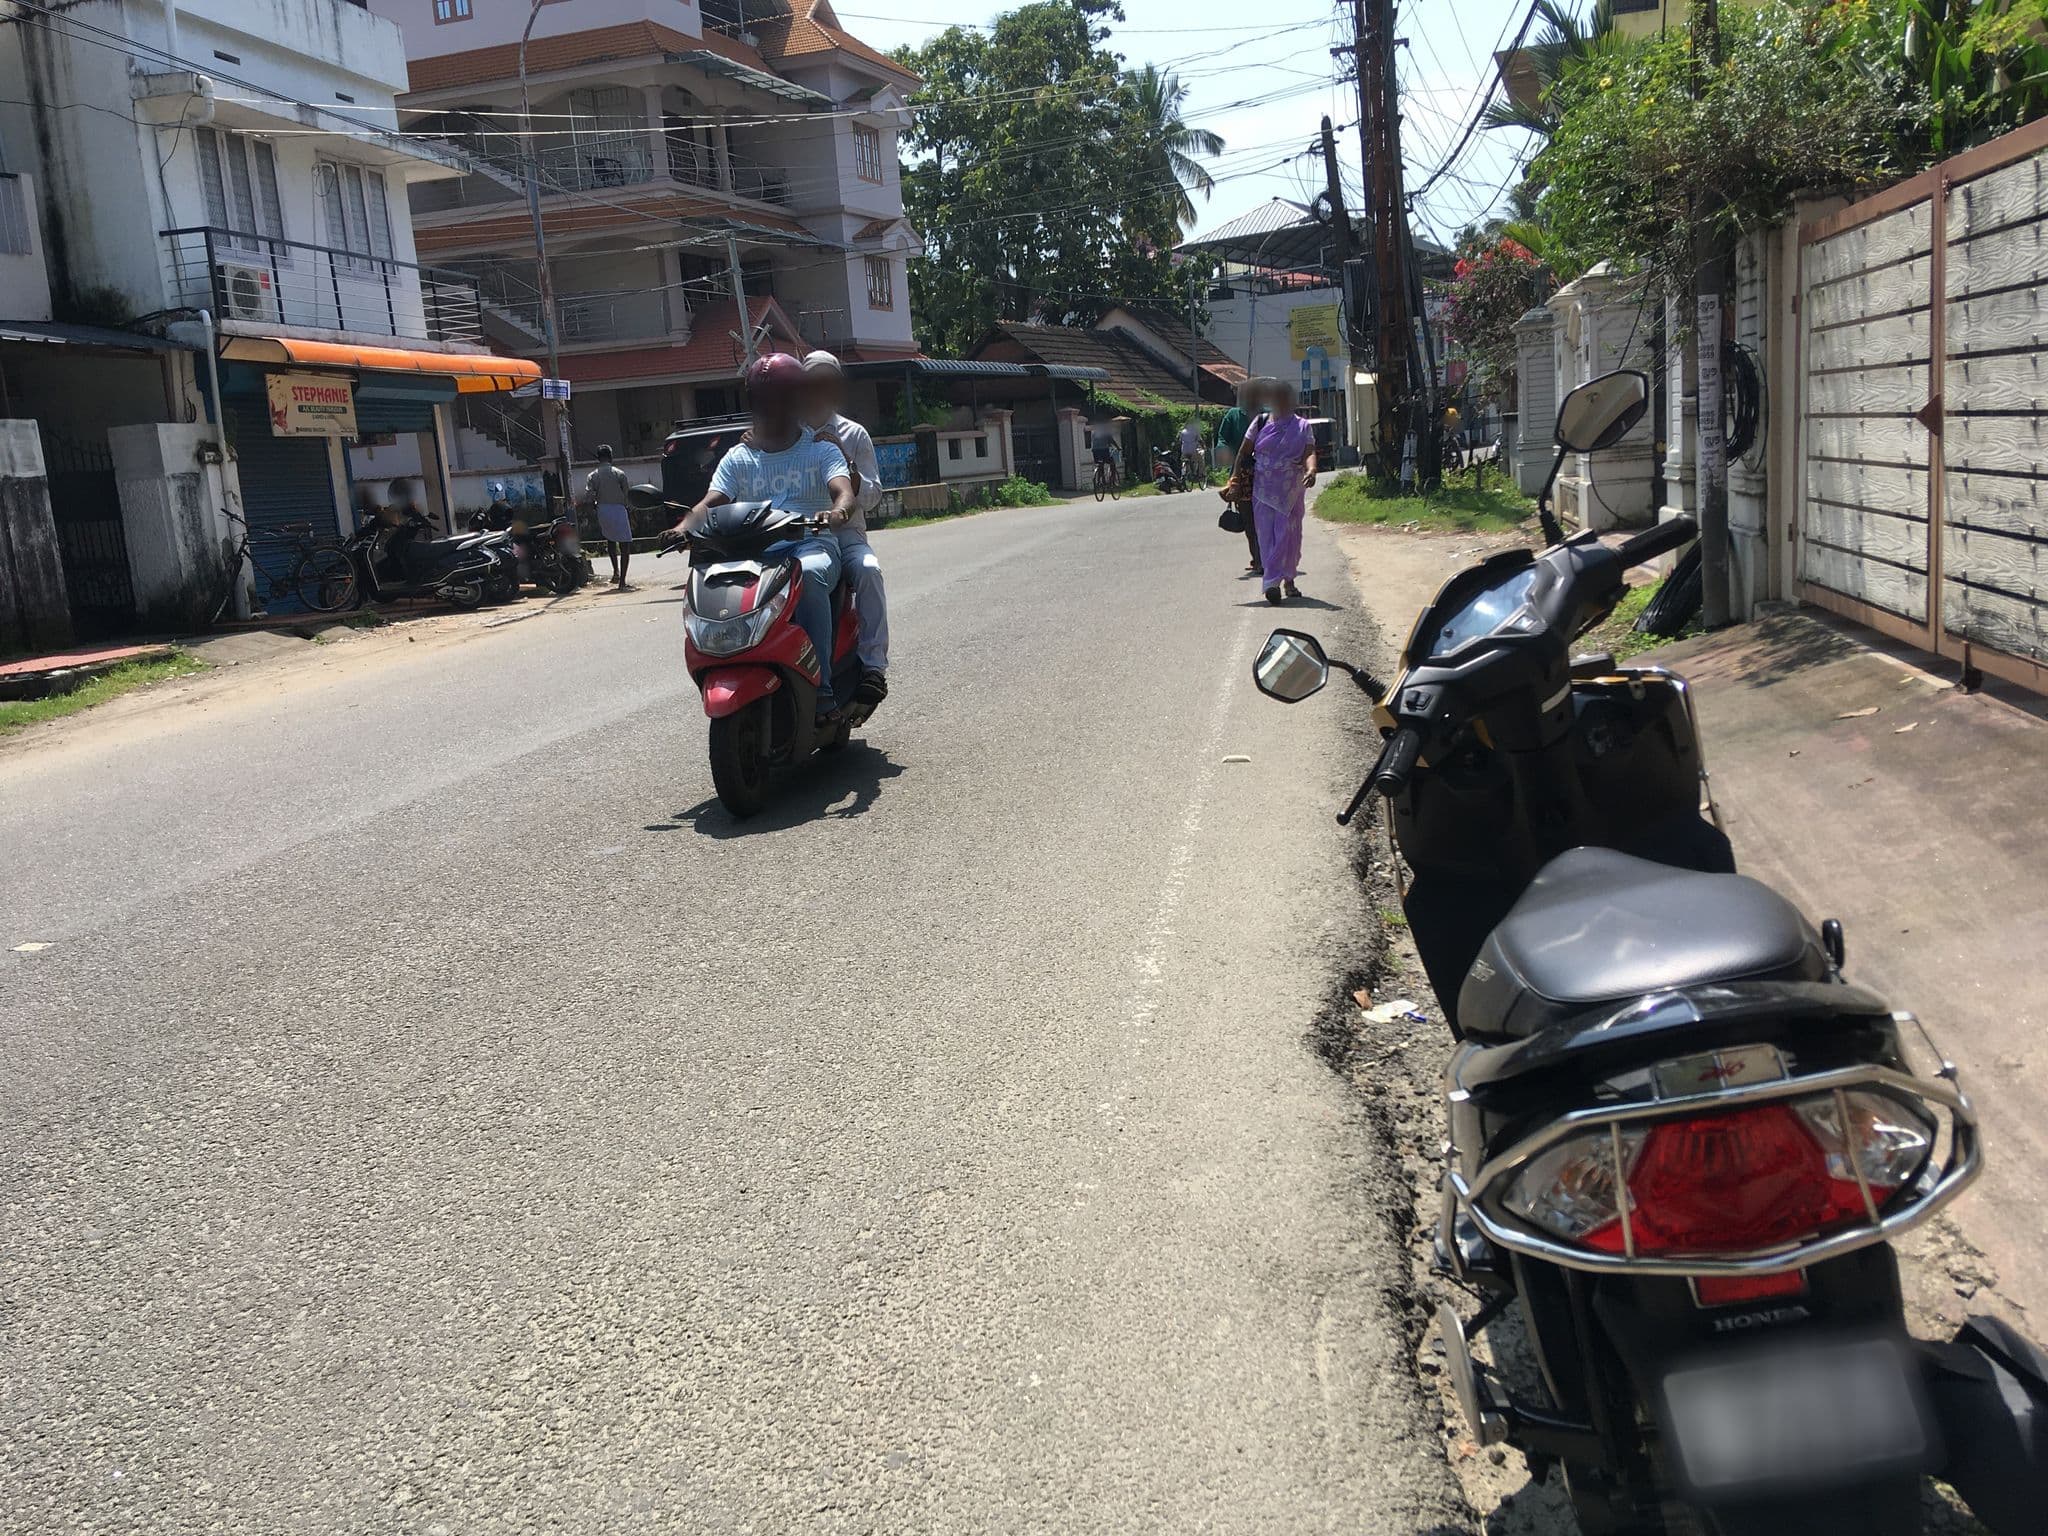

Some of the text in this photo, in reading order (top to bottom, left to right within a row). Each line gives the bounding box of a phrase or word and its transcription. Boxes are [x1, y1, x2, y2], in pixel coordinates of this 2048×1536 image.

[292, 386, 349, 403] STEPHANIE
[740, 467, 819, 497] SPORT
[1713, 1305, 1809, 1332] HONDA
